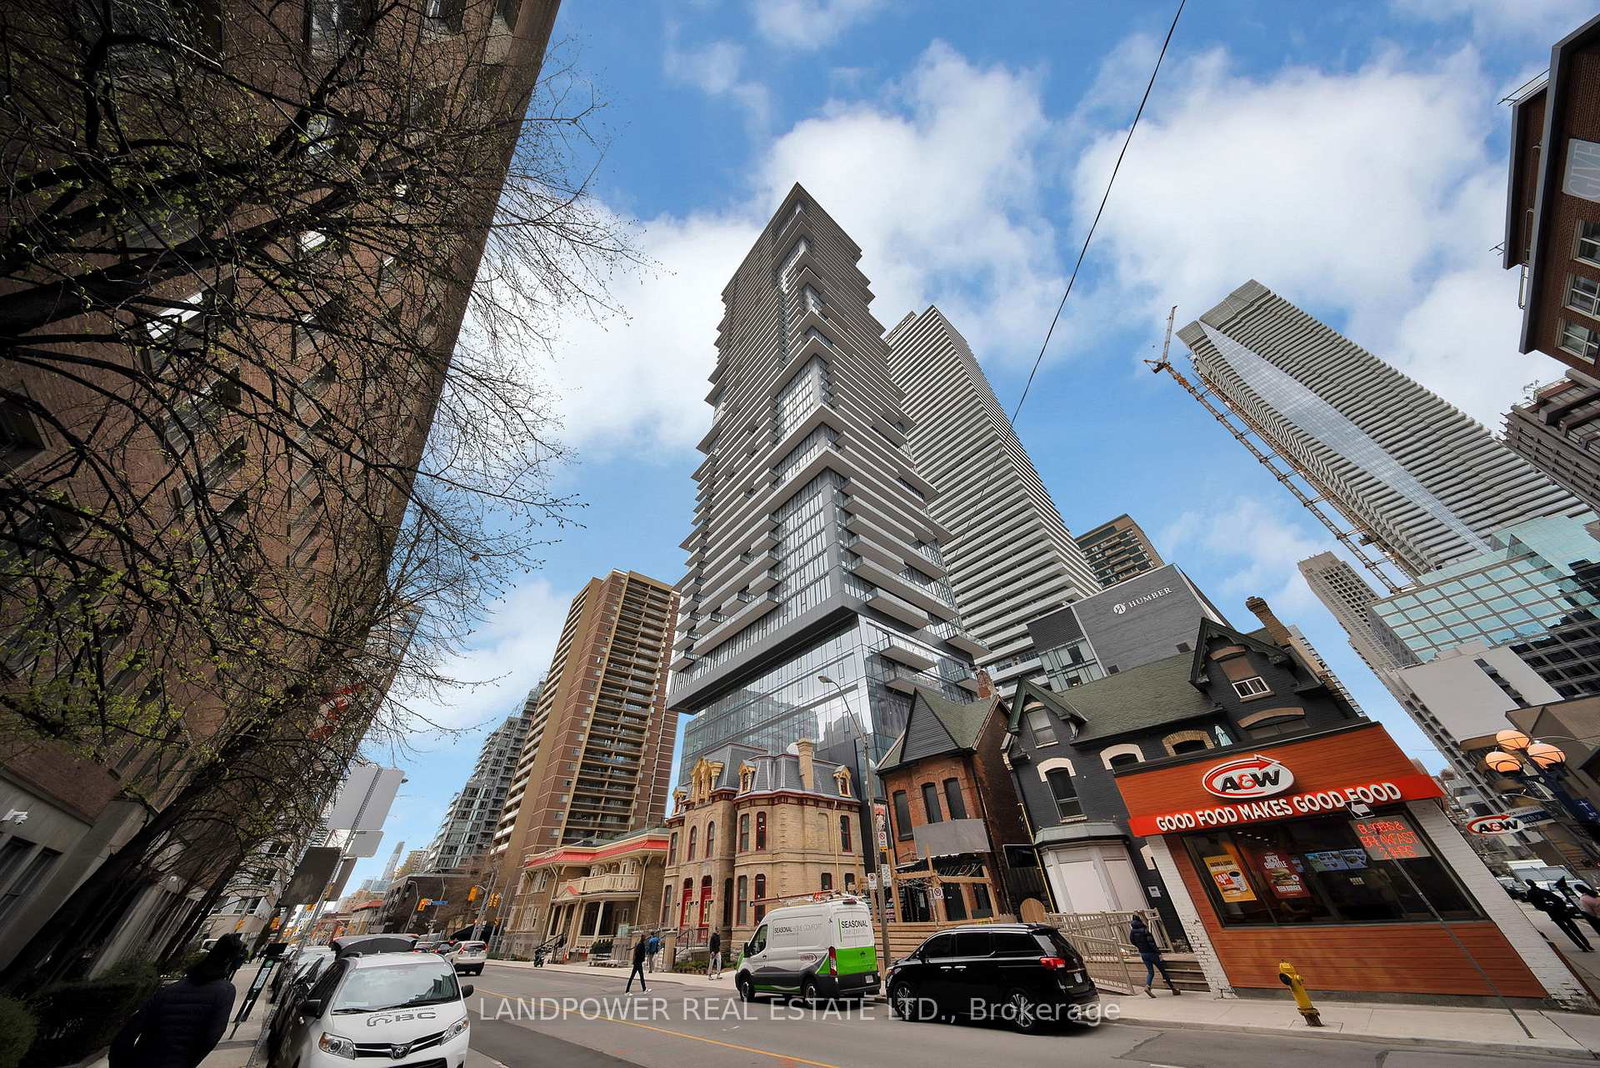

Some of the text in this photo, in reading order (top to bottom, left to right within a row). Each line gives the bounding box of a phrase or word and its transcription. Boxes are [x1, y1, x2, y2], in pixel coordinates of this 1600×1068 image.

[1128, 587, 1172, 608] HUMBER
[1220, 769, 1281, 793] A&W
[1156, 782, 1402, 832] GOOD FOOD MAKES GOOD FOOD
[1478, 819, 1518, 834] A&W
[774, 926, 793, 934] SEASONAL
[841, 920, 868, 929] SEASONAL
